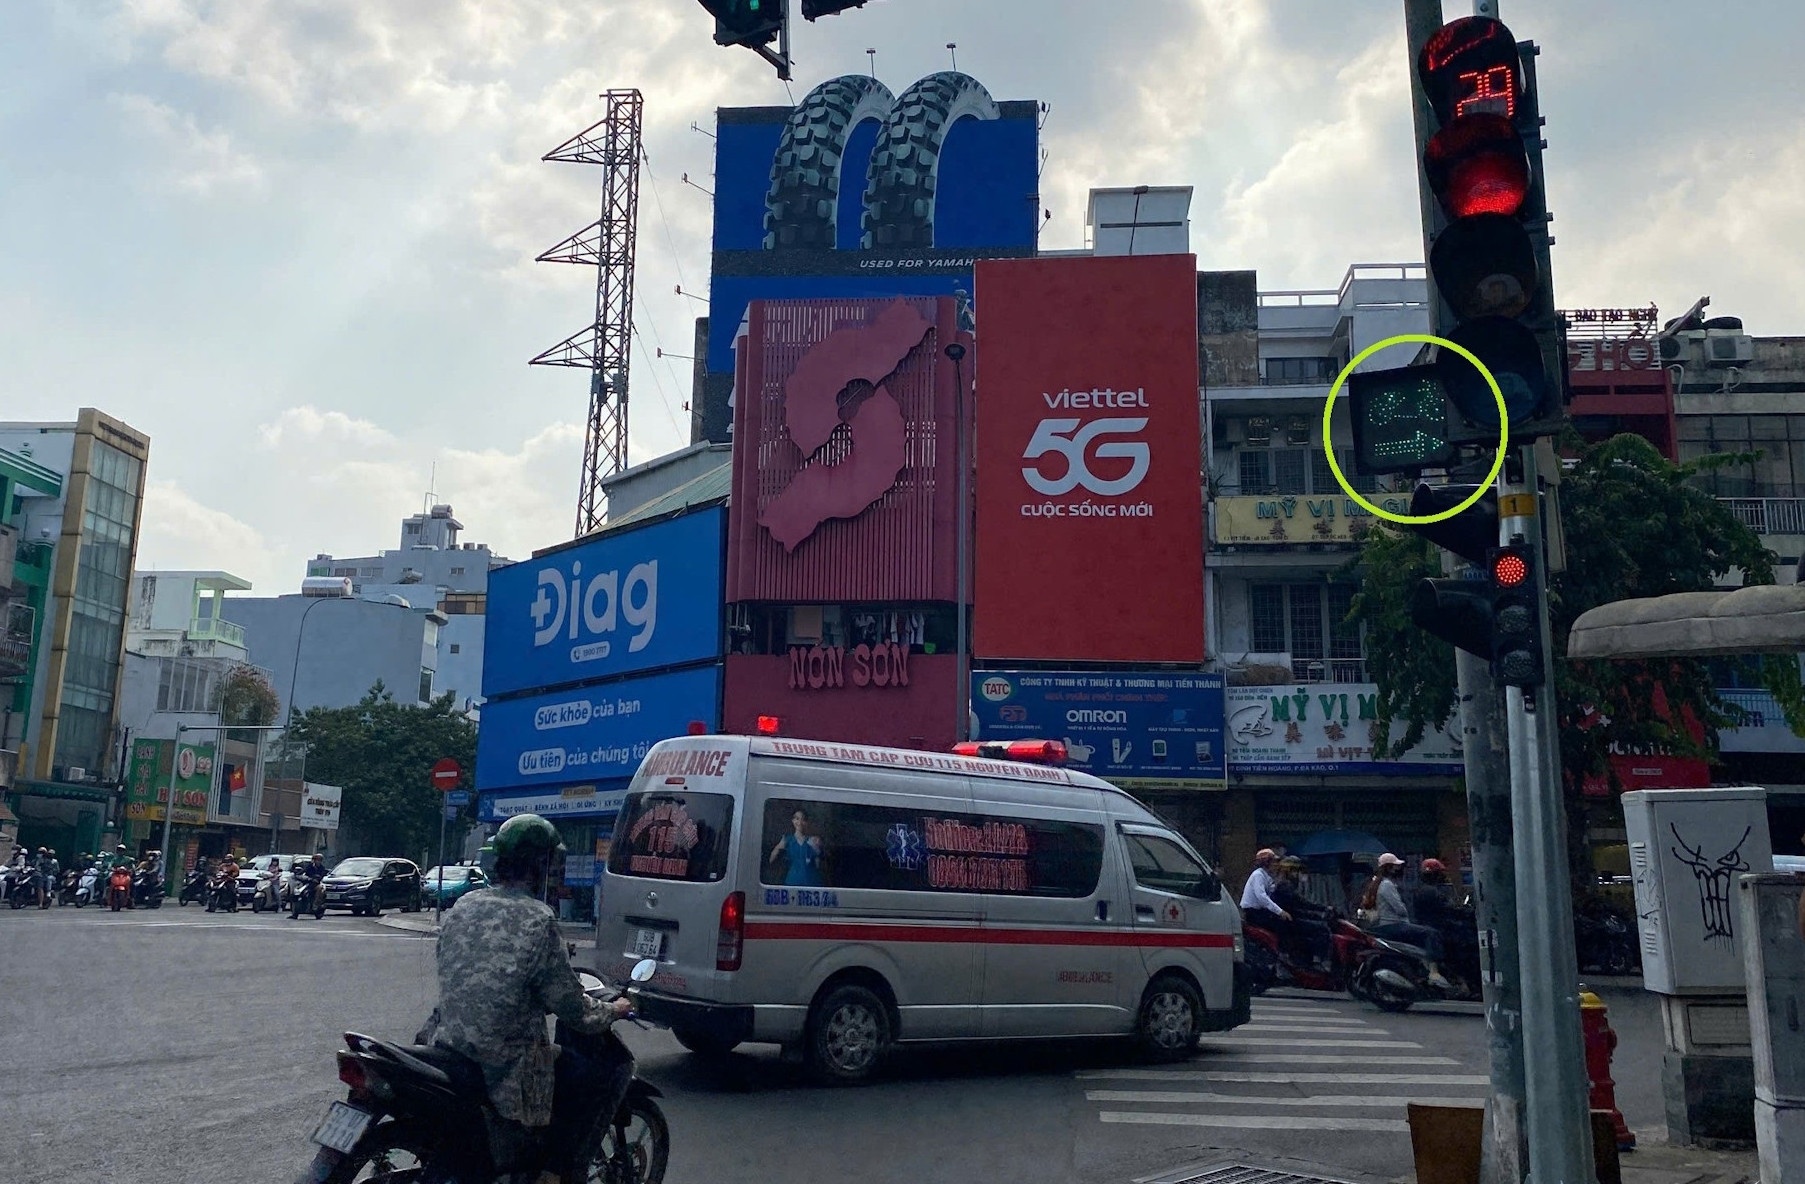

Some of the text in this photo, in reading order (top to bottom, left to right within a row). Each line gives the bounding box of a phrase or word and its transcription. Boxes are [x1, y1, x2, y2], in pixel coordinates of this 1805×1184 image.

[859, 259, 894, 268] USED
[897, 259, 923, 267] FOR
[1042, 388, 1149, 409] viettel
[1021, 417, 1150, 496] 5G
[1021, 499, 1153, 518] CUỘC SỐNG MỚI
[1257, 497, 1298, 519] MỸ
[1307, 499, 1336, 522] VỊ
[788, 638, 909, 688] NÓN SƠN
[984, 683, 1009, 694] TATC
[1020, 676, 1042, 686] CÔNG
[1044, 678, 1053, 686] TY
[1055, 678, 1075, 687] TNHH
[1077, 677, 1087, 687] KỸ
[1090, 677, 1113, 688] THUẬT
[1115, 679, 1121, 687] &
[1124, 679, 1155, 688] THƯƠNG
[1157, 680, 1173, 689] MẠI
[537, 698, 641, 726] Sức khỏe của bạn
[1066, 709, 1127, 723] OMRON
[1270, 687, 1310, 721] MỸ
[1318, 693, 1349, 727] VỊ
[567, 748, 588, 767] của
[591, 747, 630, 768] chúng
[632, 740, 650, 760] tôi
[642, 750, 731, 778] AMBULANCE
[771, 742, 827, 756] TRUNG
[935, 758, 962, 769] 115
[157, 786, 181, 803] HI
